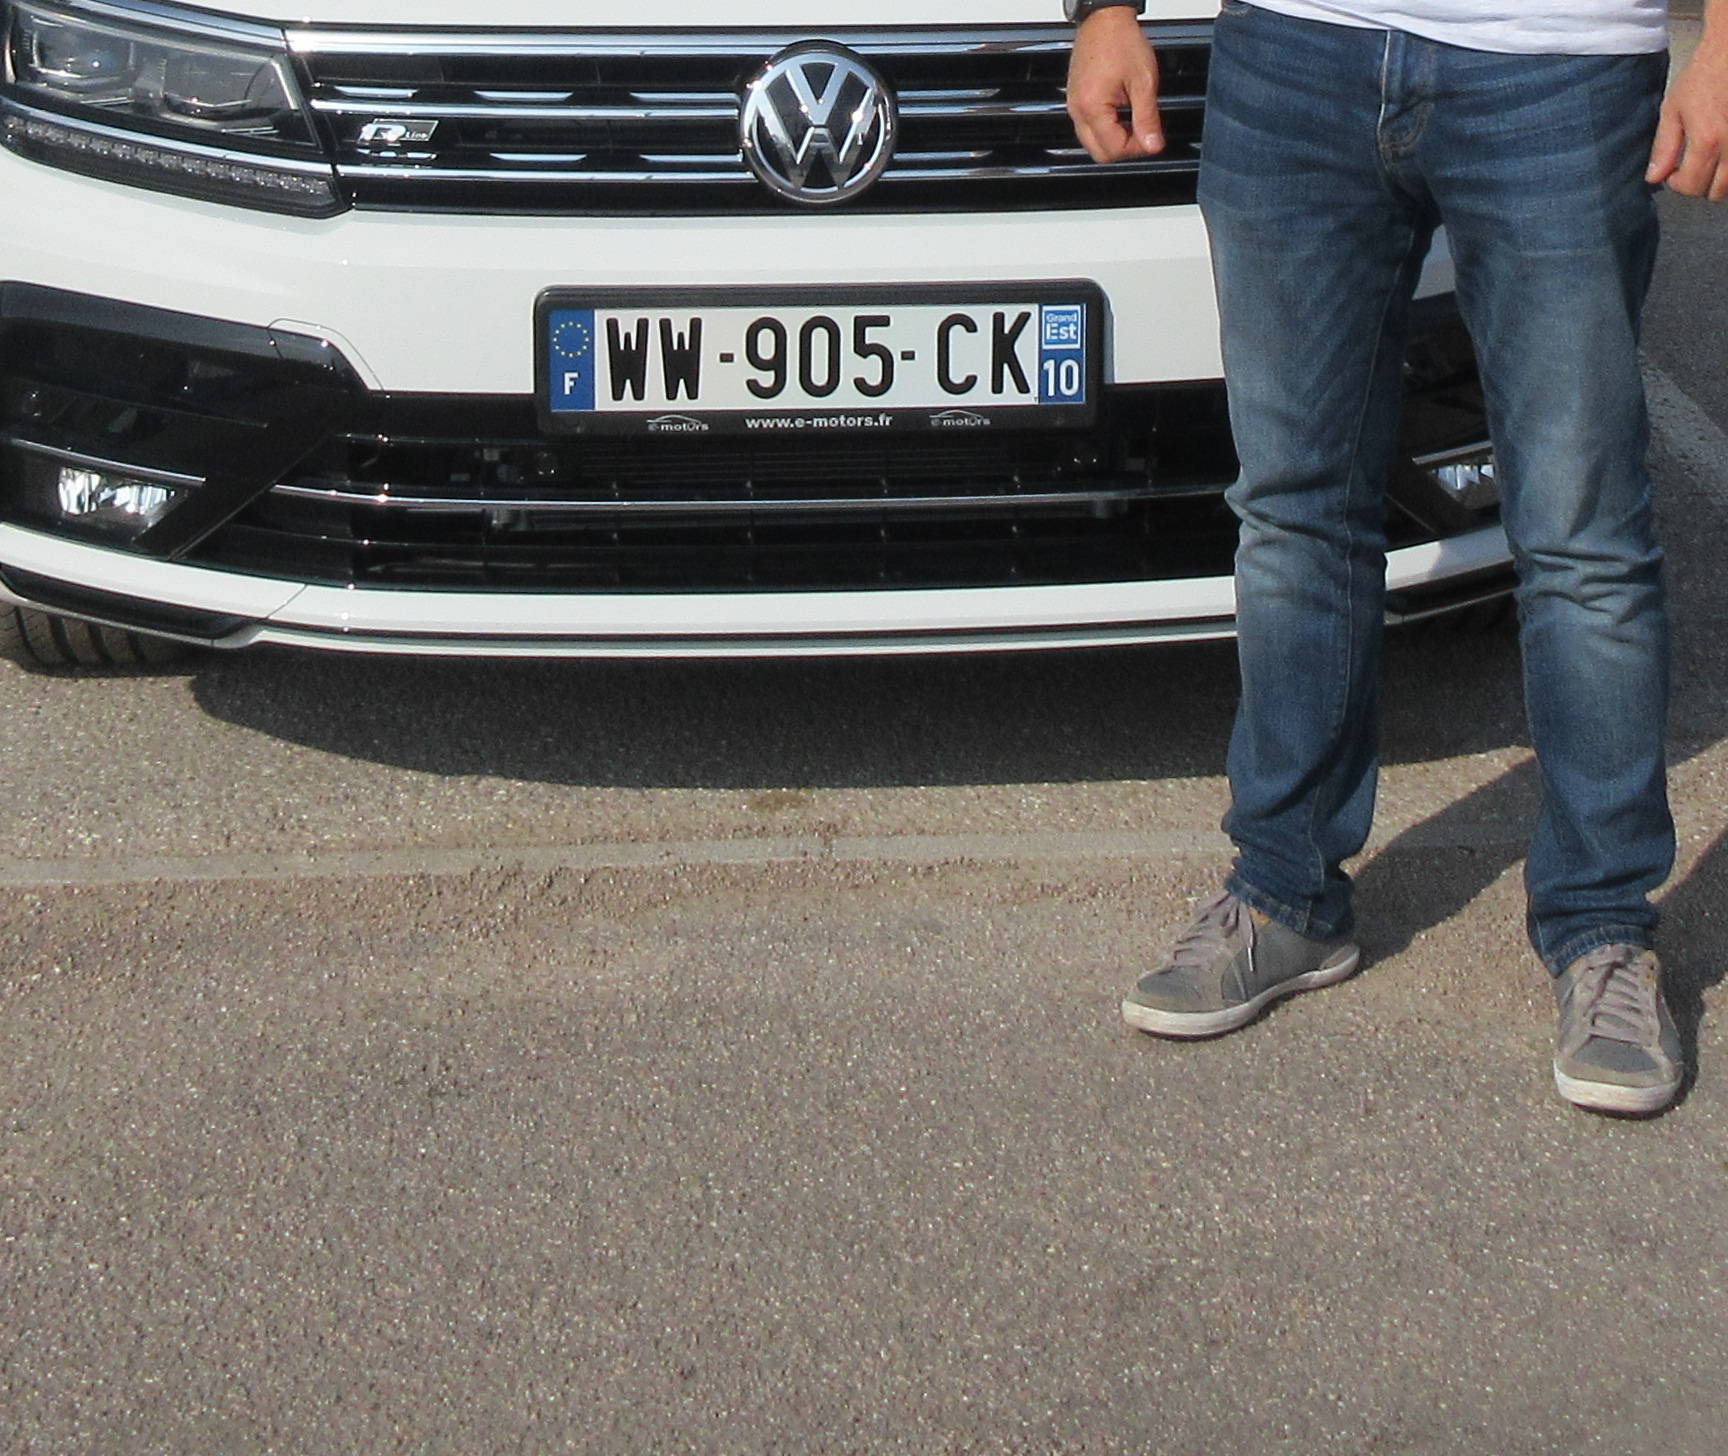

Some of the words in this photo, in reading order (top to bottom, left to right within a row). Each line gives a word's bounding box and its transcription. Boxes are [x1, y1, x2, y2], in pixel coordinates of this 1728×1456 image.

[1046, 313, 1078, 323] Grand
[1046, 323, 1077, 340] Est
[564, 372, 579, 395] F
[606, 311, 1031, 401] WW-905-CK
[1043, 358, 1079, 396] 10
[745, 412, 893, 429] www.e-motors.fr
